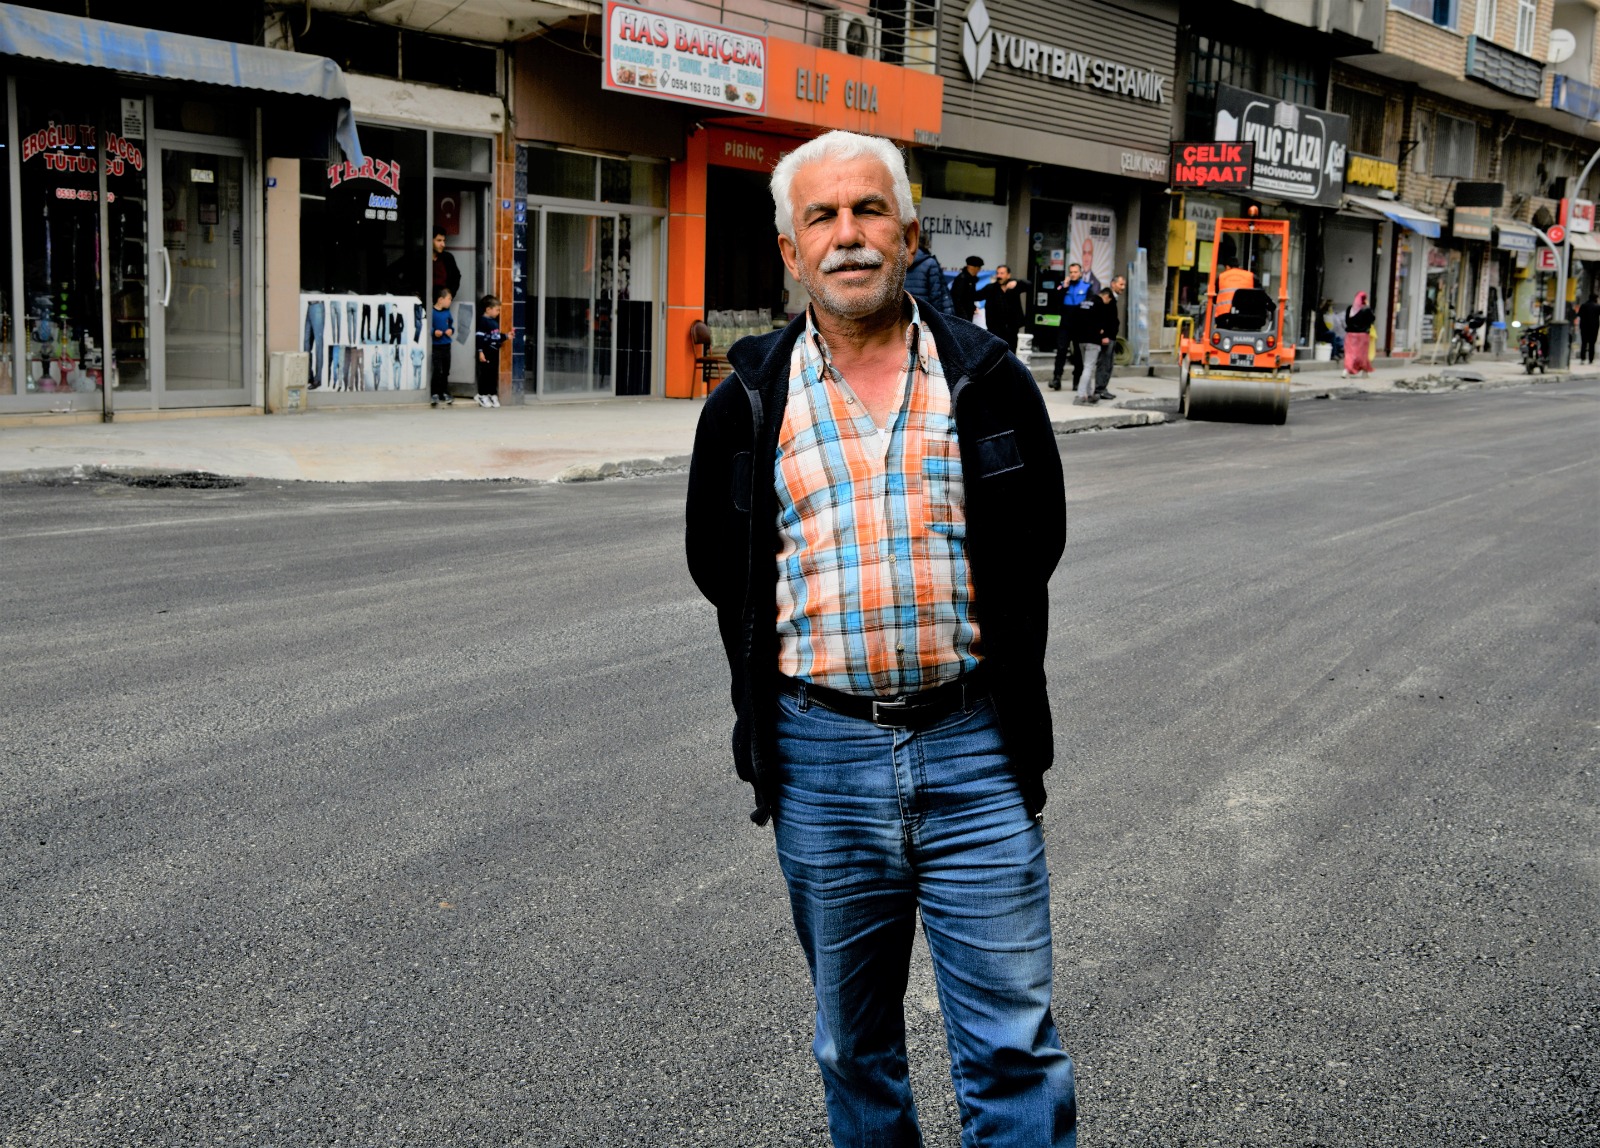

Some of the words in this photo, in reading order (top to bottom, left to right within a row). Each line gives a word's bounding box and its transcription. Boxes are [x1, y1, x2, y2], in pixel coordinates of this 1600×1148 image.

[619, 11, 669, 48] HAS
[674, 23, 762, 69] BAHÇEM
[995, 32, 1090, 84] YURTBAY
[1091, 59, 1165, 103] SERAMİK
[671, 78, 688, 90] 0554
[689, 82, 702, 93] 163
[703, 84, 712, 95] 72
[713, 86, 721, 97] 03
[796, 67, 830, 103] ELİF
[844, 79, 879, 113] GIDA
[22, 120, 76, 162] EROĞLU
[725, 139, 764, 164] PİRİNÇ
[1245, 121, 1283, 166] KILIÇ
[1283, 130, 1321, 169] PLAZA
[1121, 152, 1142, 173] ÇELİK
[1142, 153, 1167, 177] İNŞAAT
[1183, 143, 1242, 165] ÇELİK
[327, 155, 400, 195] TERZİ
[1175, 163, 1247, 186] İNŞAAT
[1254, 163, 1312, 182] SHOWROOM
[955, 215, 992, 240] İNŞAAT
